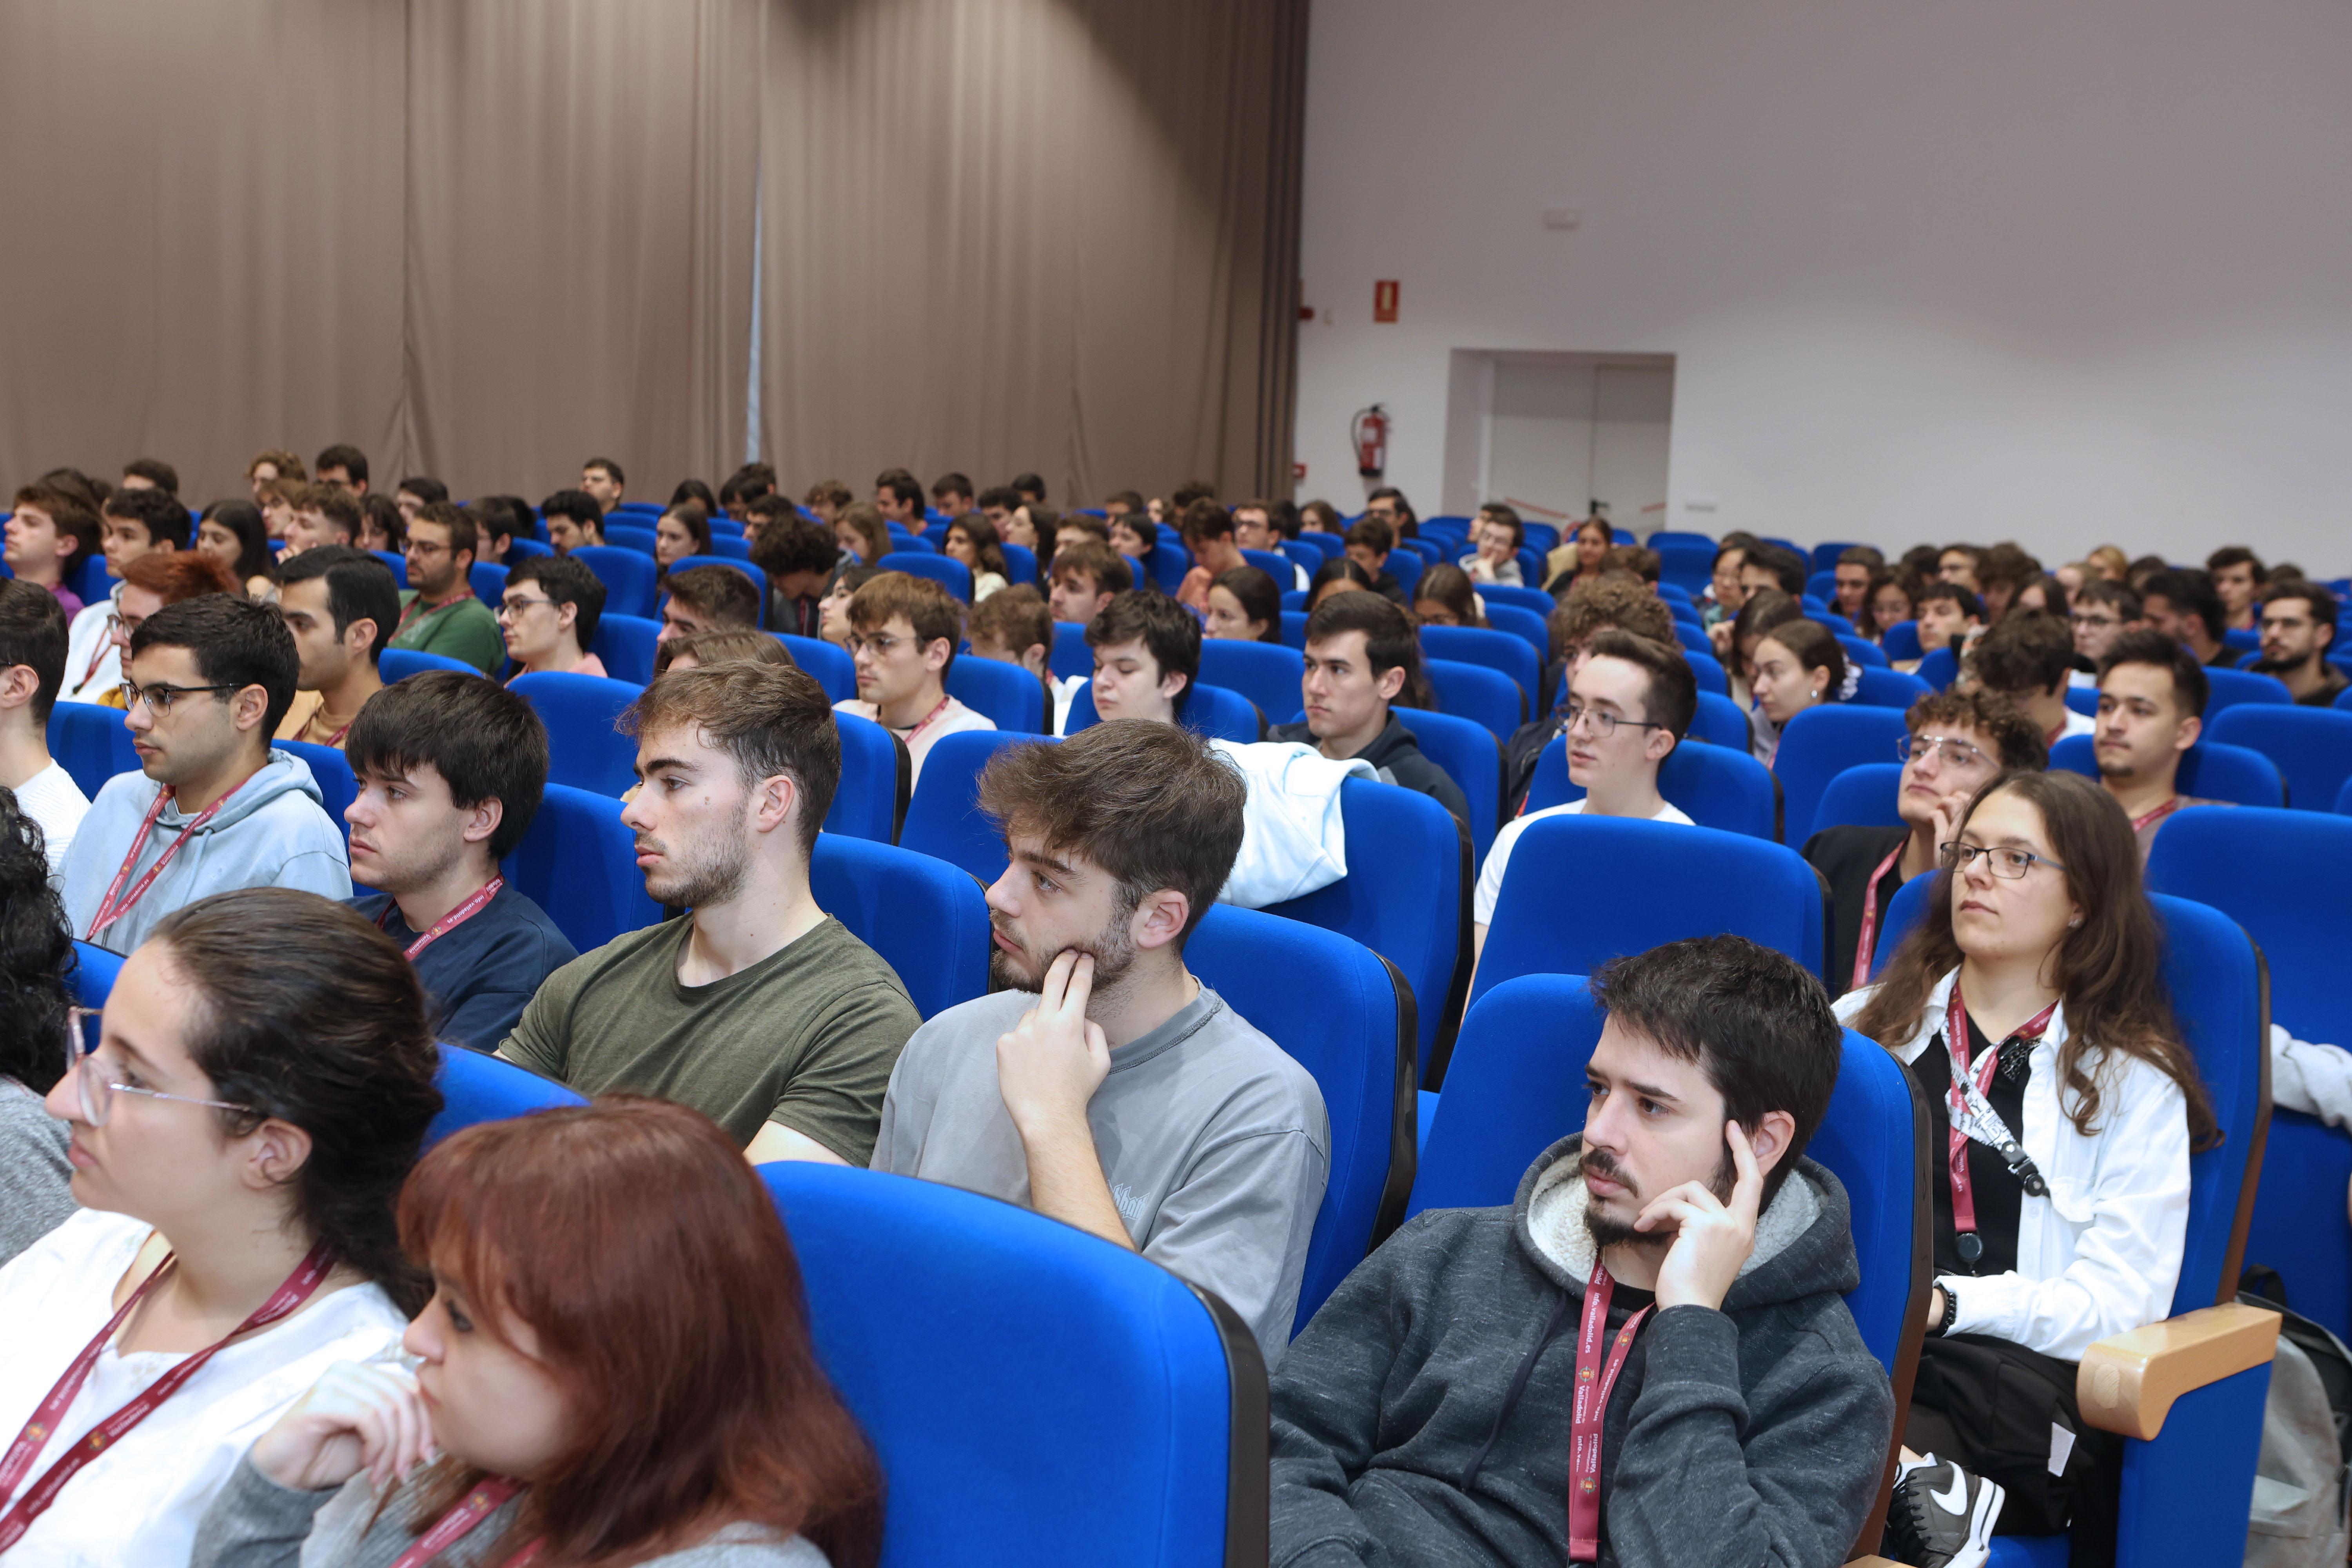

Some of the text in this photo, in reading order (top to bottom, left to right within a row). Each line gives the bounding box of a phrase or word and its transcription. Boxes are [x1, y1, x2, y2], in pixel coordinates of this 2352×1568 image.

[447, 895, 485, 924] info.valladolid.es
[409, 934, 430, 954] Valladolid
[1585, 1292, 1601, 1353] info.valladolid.es
[1575, 1385, 1585, 1424] Valladolid
[1593, 1359, 1619, 1421] info.valladolid.es
[1590, 1433, 1598, 1474] Valladolid
